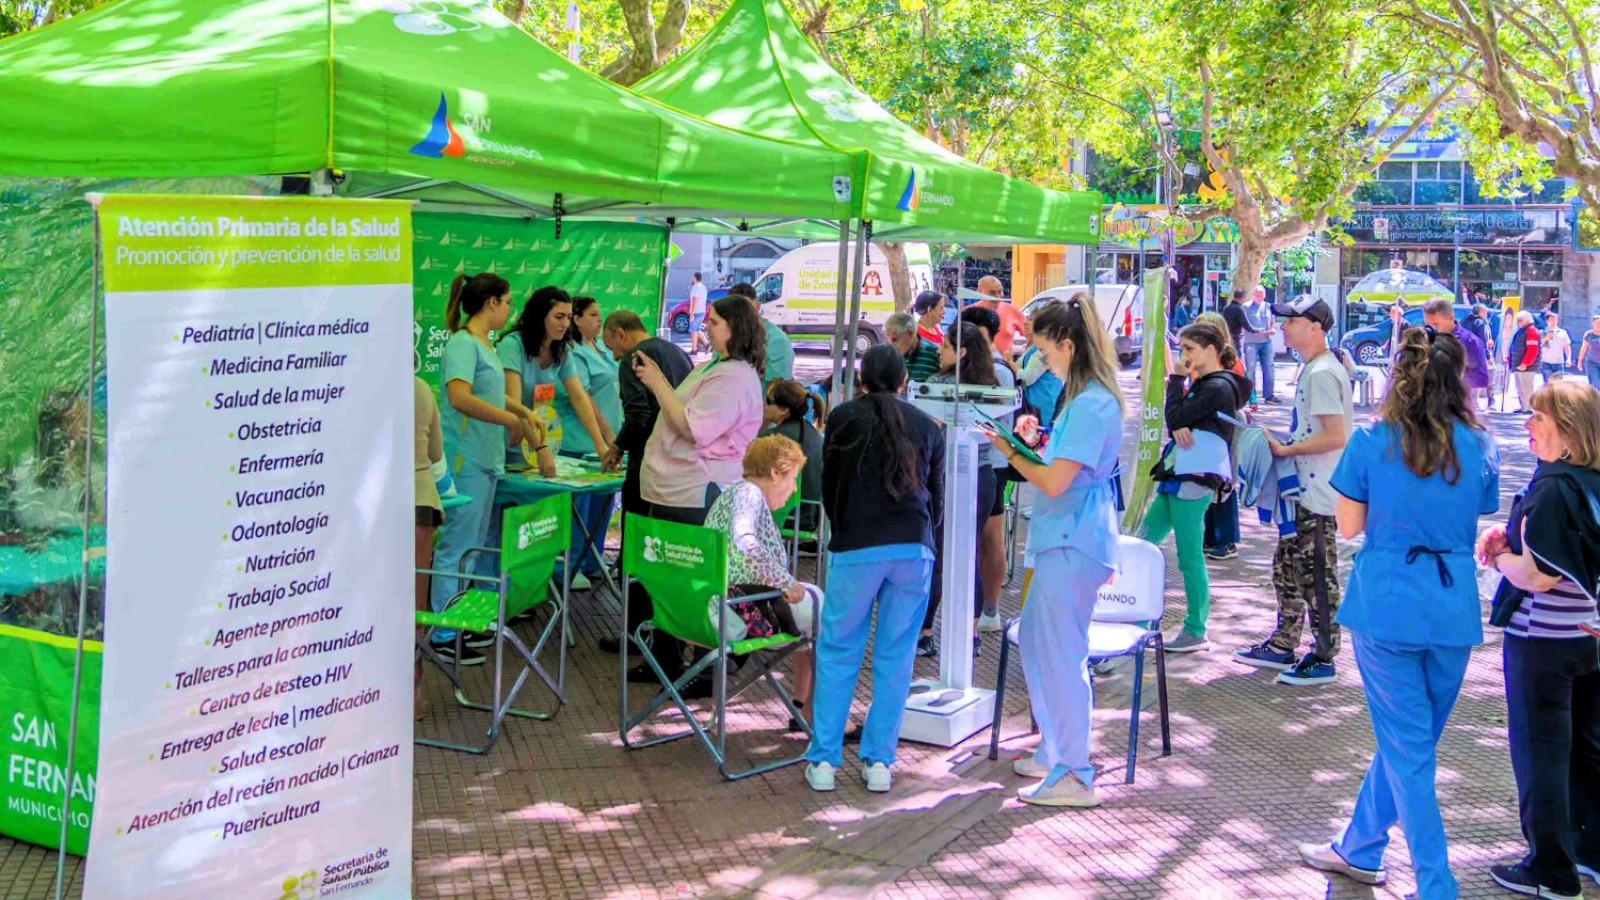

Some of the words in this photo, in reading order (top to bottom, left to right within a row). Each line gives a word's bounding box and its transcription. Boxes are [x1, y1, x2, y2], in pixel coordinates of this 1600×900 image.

[464, 112, 492, 133] SAN
[117, 216, 214, 238] Atención
[217, 216, 301, 237] Primaria
[304, 217, 328, 236] de
[331, 217, 347, 236] la
[351, 216, 400, 237] Salud
[116, 246, 214, 266] Promoción
[217, 250, 228, 269] y
[231, 245, 322, 267] prevención
[325, 244, 344, 263] de
[348, 244, 361, 262] la
[364, 243, 401, 262] salud
[182, 325, 254, 344] Pediatría
[265, 321, 315, 340] Clínica
[318, 319, 369, 336] médica
[210, 355, 283, 376] Medicina
[286, 352, 347, 370] Familiar
[213, 388, 259, 410] Salud
[262, 387, 281, 405] de
[284, 385, 298, 404] la
[301, 383, 345, 408] mujer
[238, 418, 322, 441] Obstetricia
[238, 450, 324, 474] Enfermería
[236, 482, 325, 508] Vacunación
[231, 512, 329, 542] Odontología
[245, 547, 316, 573] Nutrición
[227, 585, 286, 611] Trabajo
[288, 572, 331, 598] Social
[213, 623, 269, 649] Agente
[270, 605, 343, 637] promotor
[175, 665, 234, 691] Talleres
[236, 653, 272, 675] para
[275, 647, 289, 663] la
[290, 626, 374, 659] comunidad
[199, 692, 250, 716] Centro
[253, 686, 272, 702] de
[274, 673, 322, 696] testeo
[324, 663, 353, 685] HIV
[11, 711, 57, 750] SAN
[160, 729, 224, 761] Entrega
[226, 722, 245, 740] de
[247, 711, 290, 733] leche
[298, 687, 381, 722] medicación
[219, 747, 267, 774] Salud
[269, 733, 327, 760] escolar
[127, 798, 203, 835] Atención
[206, 789, 233, 810] del
[235, 775, 286, 802] recién
[288, 761, 339, 791] nacido
[347, 743, 400, 771] Crianza
[8, 796, 90, 828] MUNICIIO
[222, 799, 321, 840] Puericultura
[321, 870, 352, 886] Salud
[353, 860, 390, 878] Pública
[324, 851, 374, 876] Secretaría
[375, 847, 388, 859] de
[320, 887, 335, 896] San
[336, 877, 373, 893] Fernando
